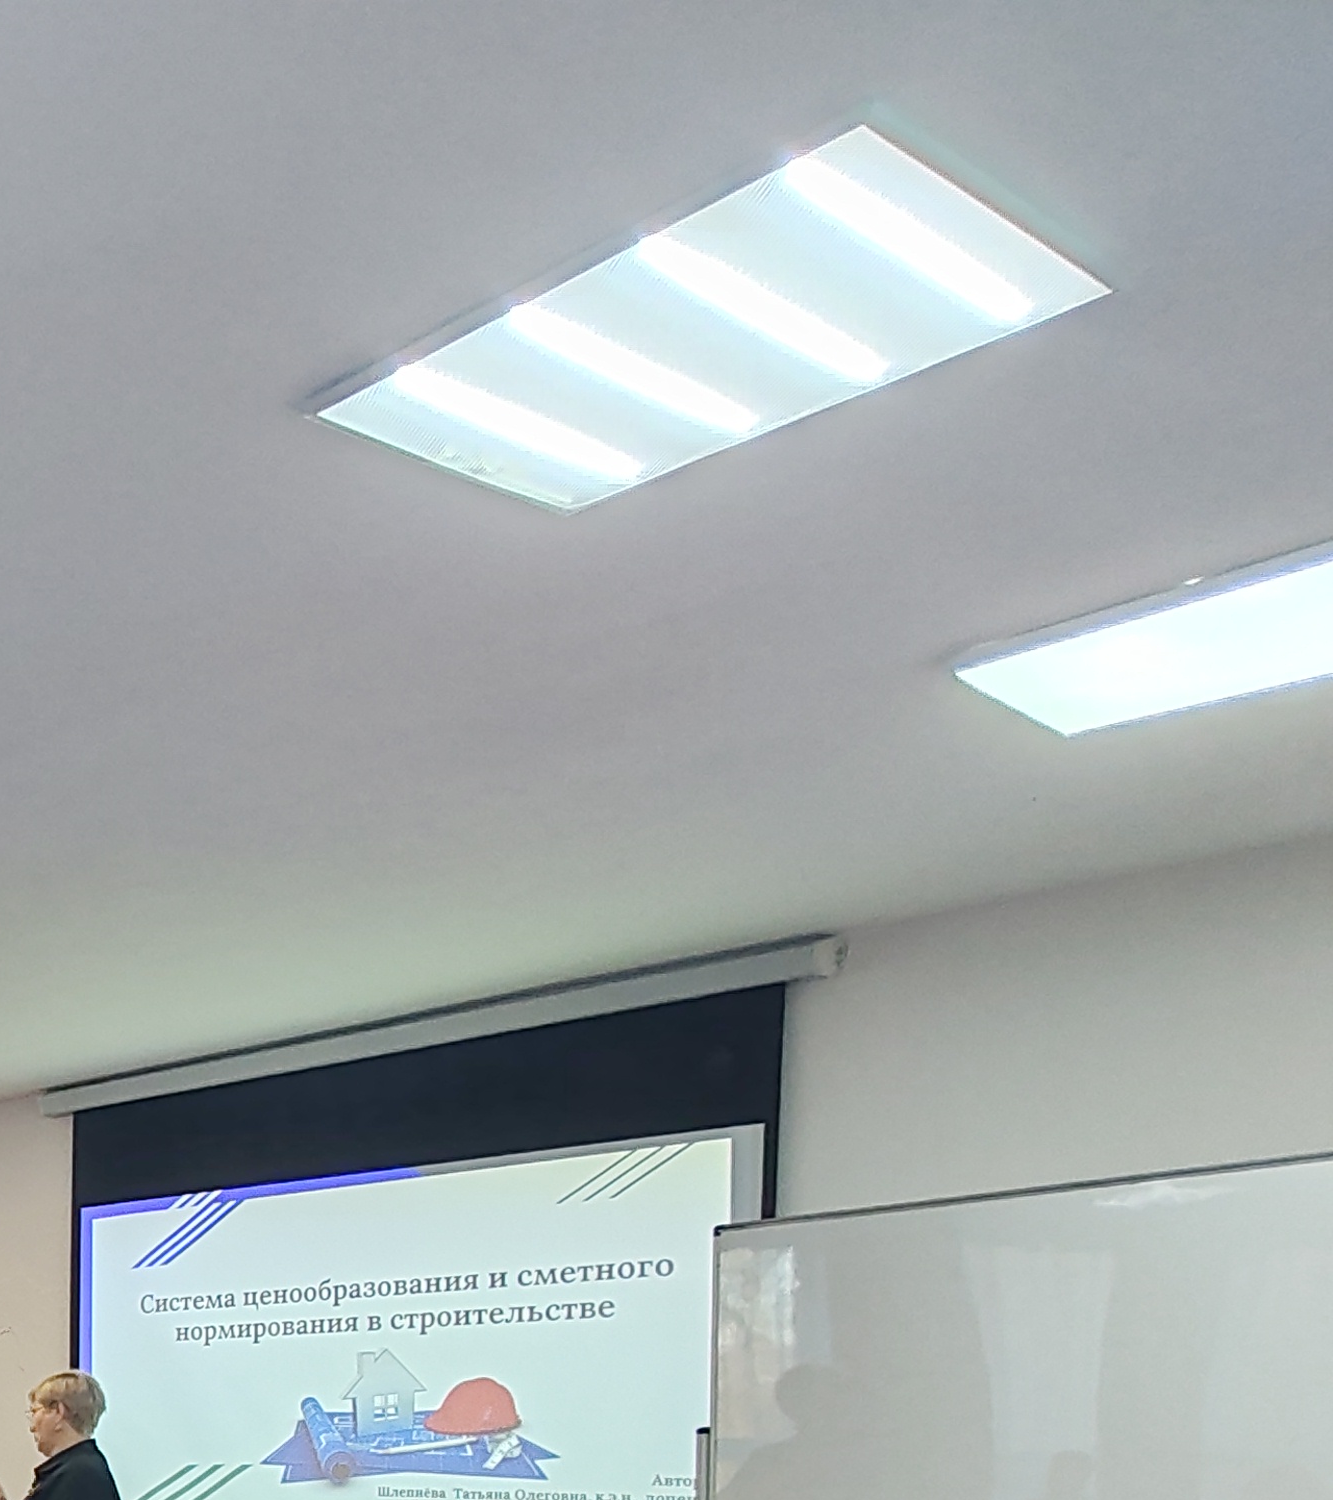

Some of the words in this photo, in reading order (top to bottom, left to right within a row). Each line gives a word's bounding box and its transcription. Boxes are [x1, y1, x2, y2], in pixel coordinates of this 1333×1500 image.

[140, 1292, 237, 1314] Система
[243, 1273, 479, 1311] ценообразования
[488, 1271, 508, 1289] и
[517, 1257, 675, 1287] сметного
[175, 1315, 359, 1346] нормирования
[367, 1314, 382, 1332] в
[390, 1298, 616, 1335] строительстве
[377, 1486, 446, 1499] Шлепнёва
[453, 1488, 510, 1500] Татьяна
